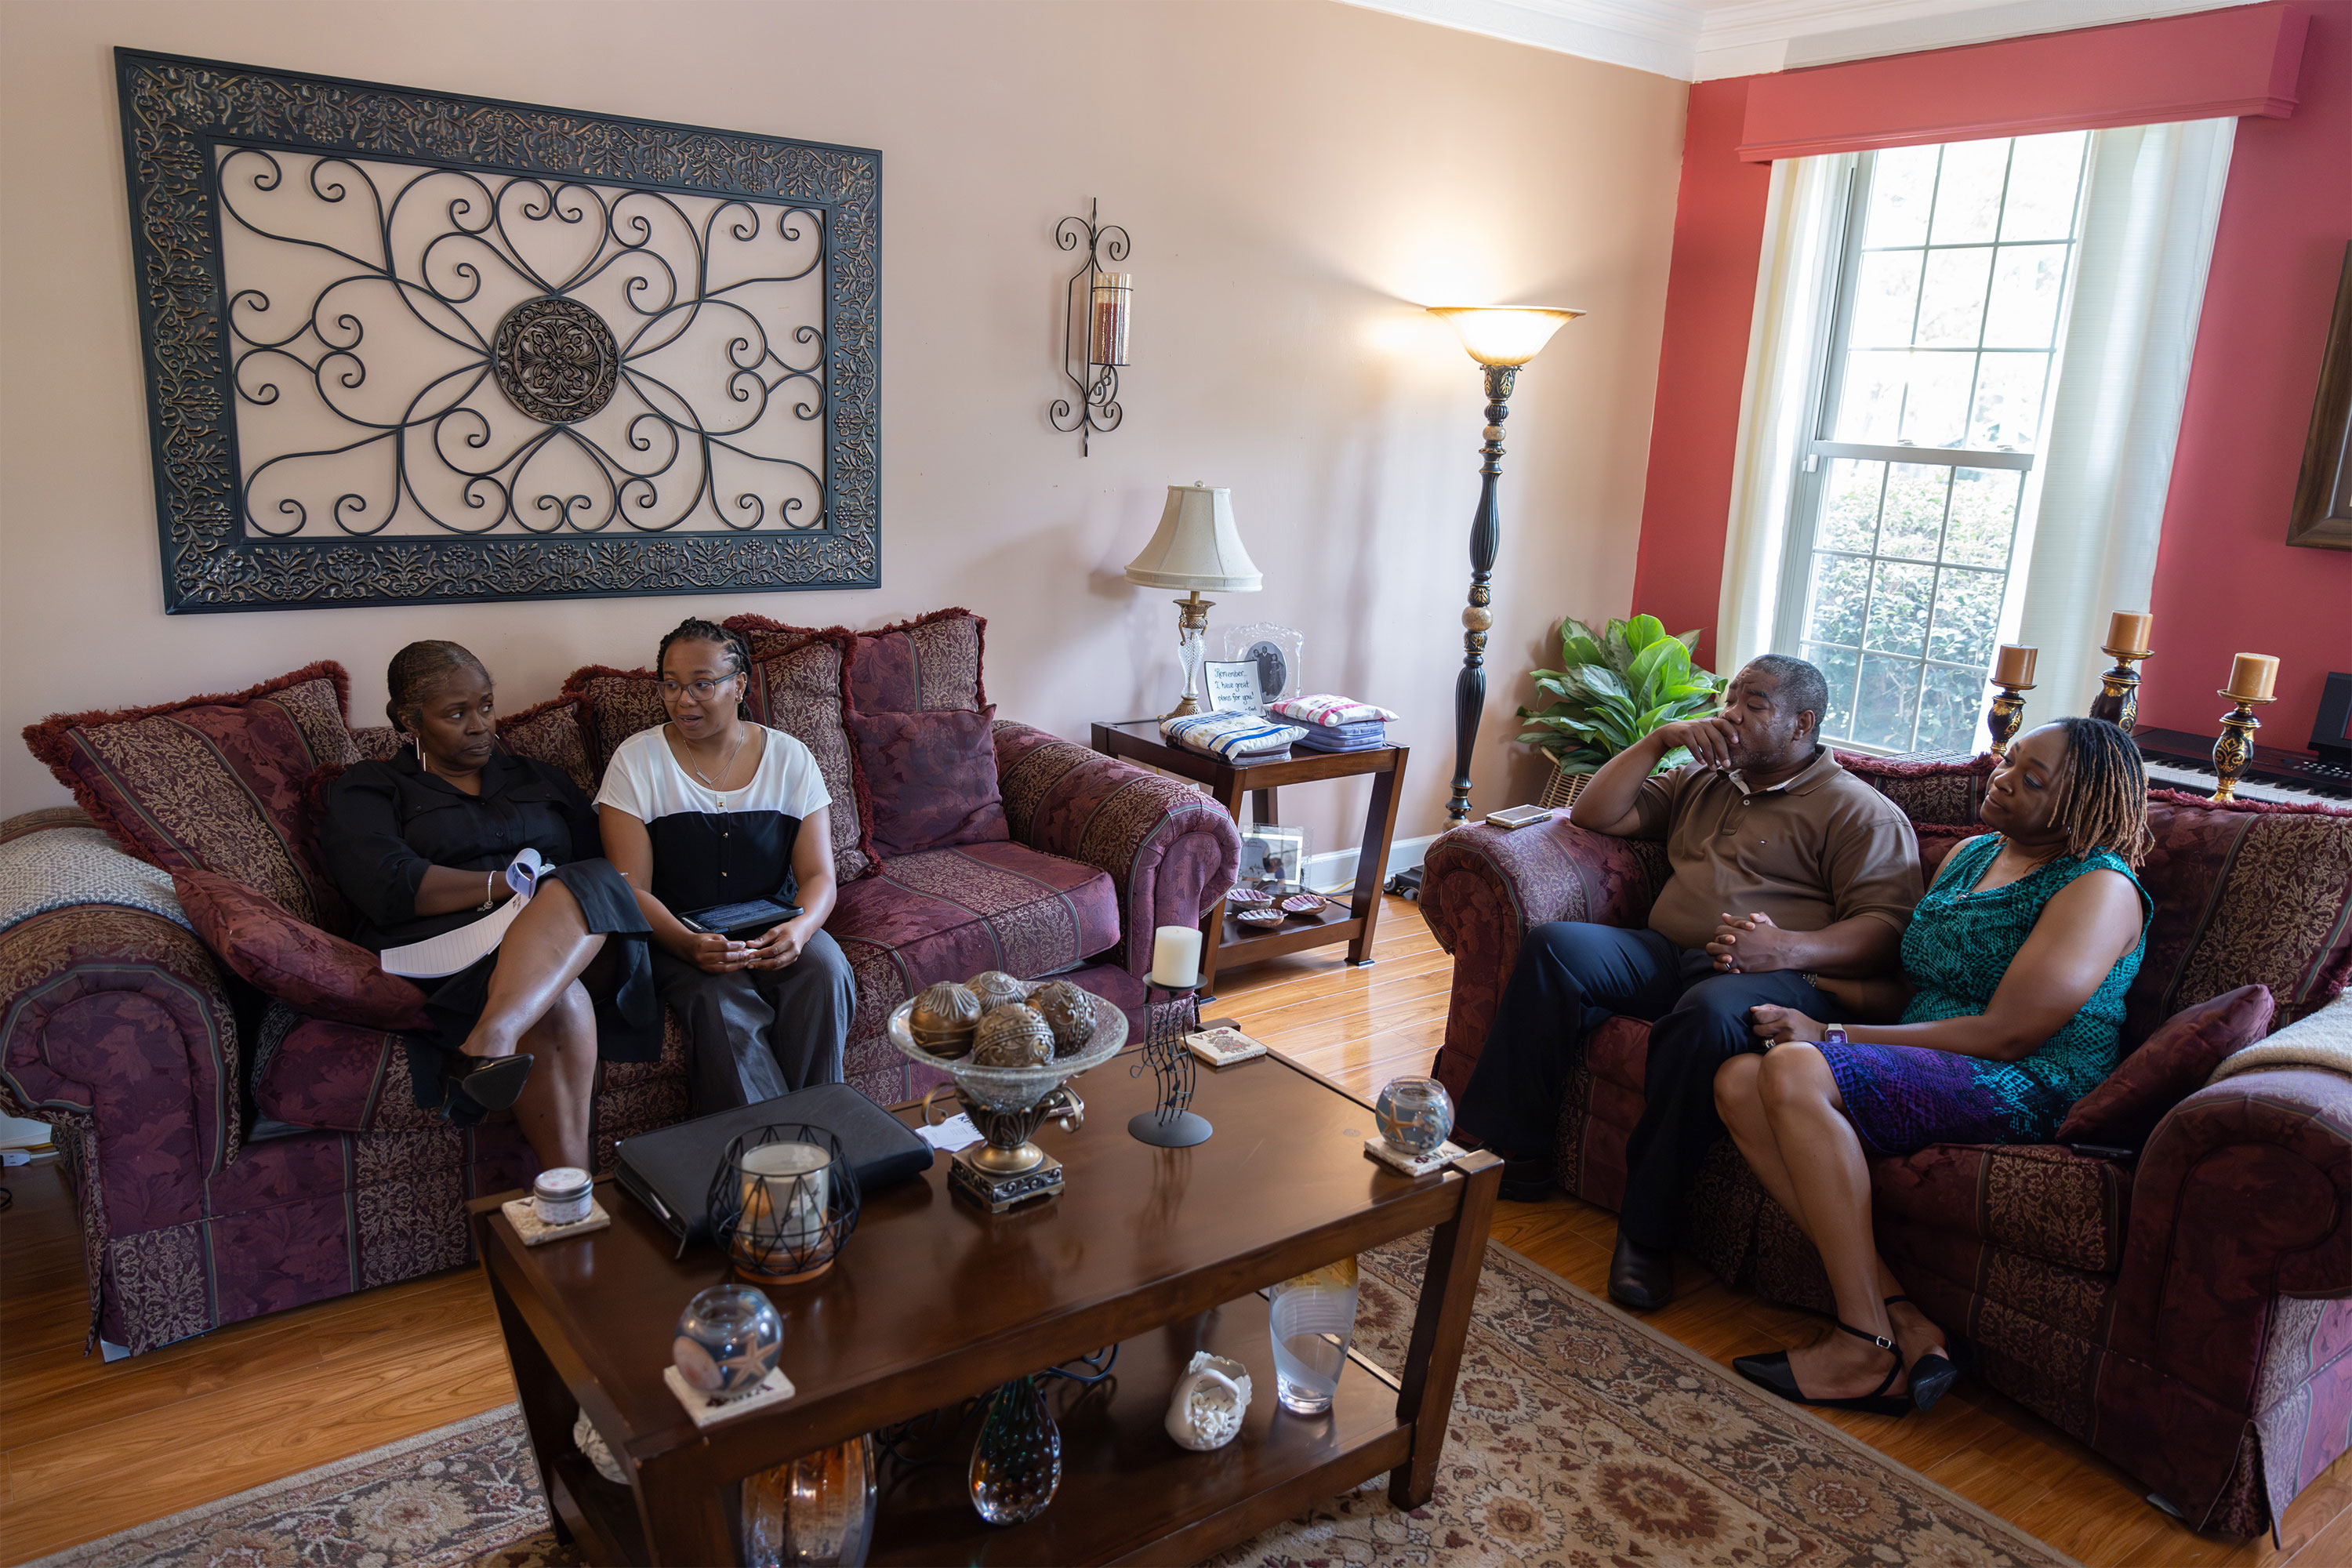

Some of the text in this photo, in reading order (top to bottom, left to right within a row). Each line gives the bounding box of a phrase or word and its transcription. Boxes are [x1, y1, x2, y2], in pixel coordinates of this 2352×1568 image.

[1214, 681, 1220, 689] I
[1235, 680, 1250, 692] great
[1218, 691, 1254, 705] plans for you!
